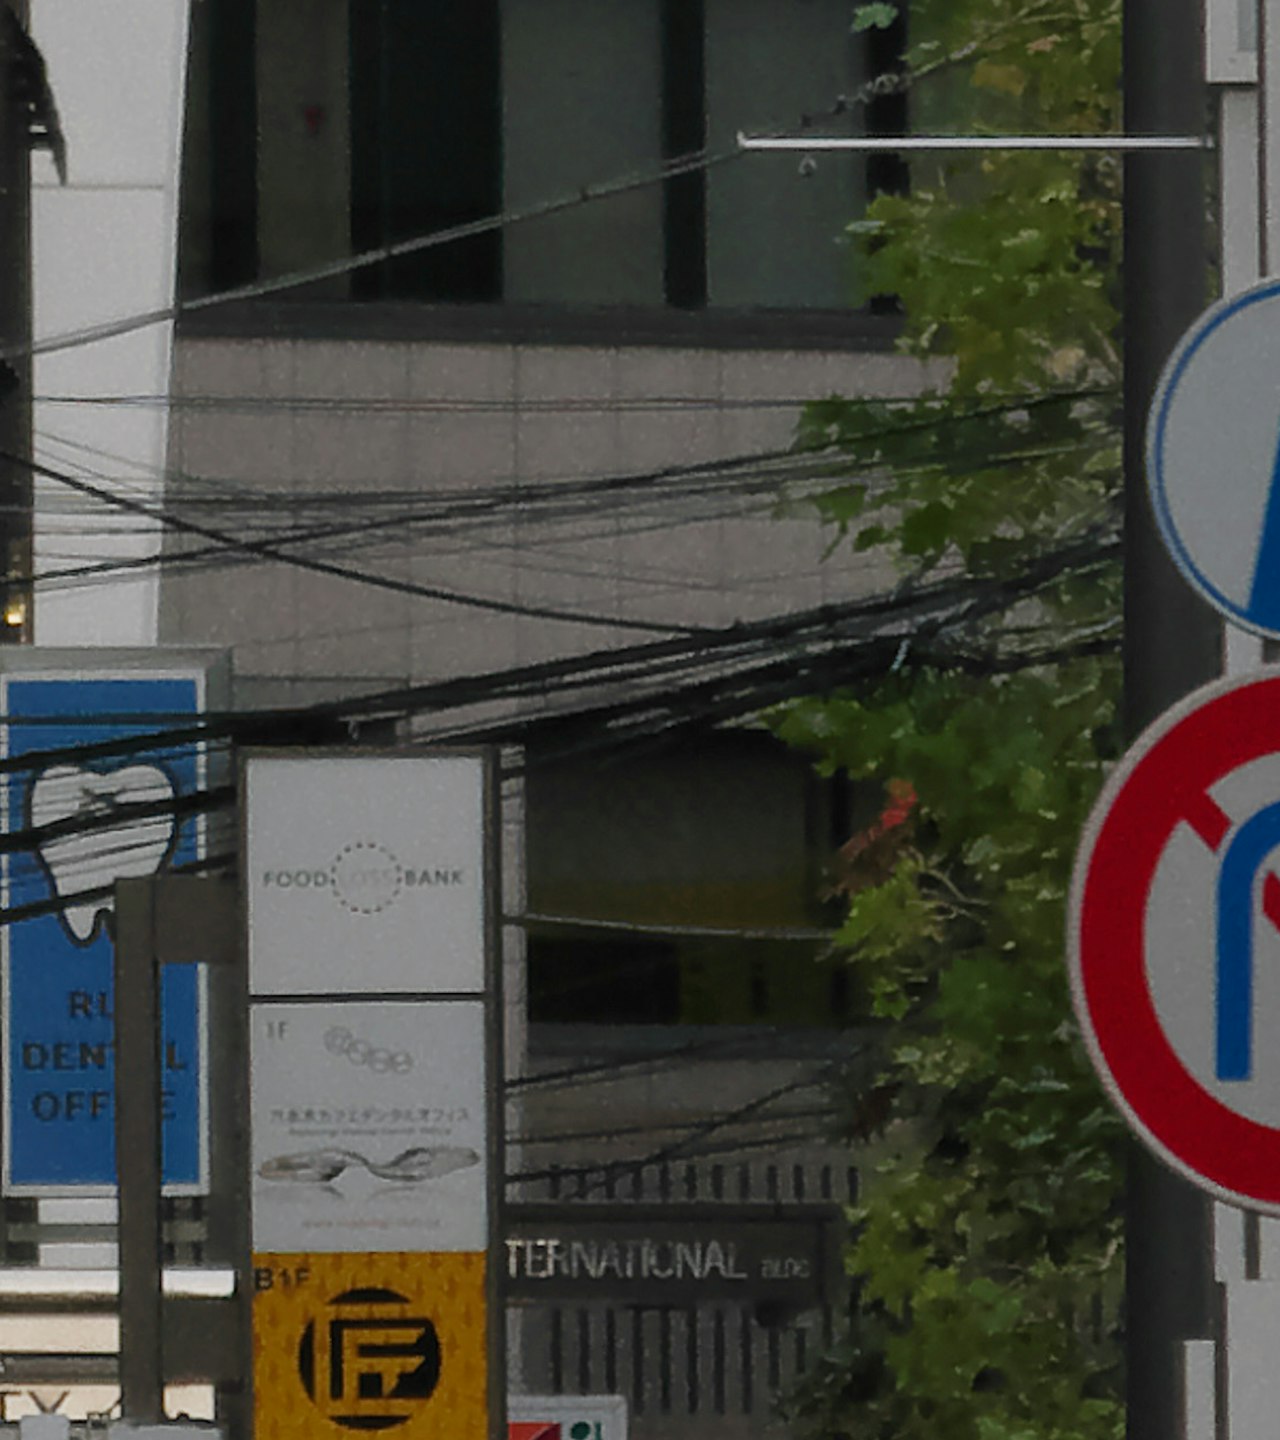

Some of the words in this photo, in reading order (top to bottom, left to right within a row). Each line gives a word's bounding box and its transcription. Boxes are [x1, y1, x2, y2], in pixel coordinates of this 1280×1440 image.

[263, 869, 329, 888] FOOD
[405, 869, 464, 887] BANK
[32, 1091, 177, 1122] OFFE
[254, 1268, 313, 1292] B1F
